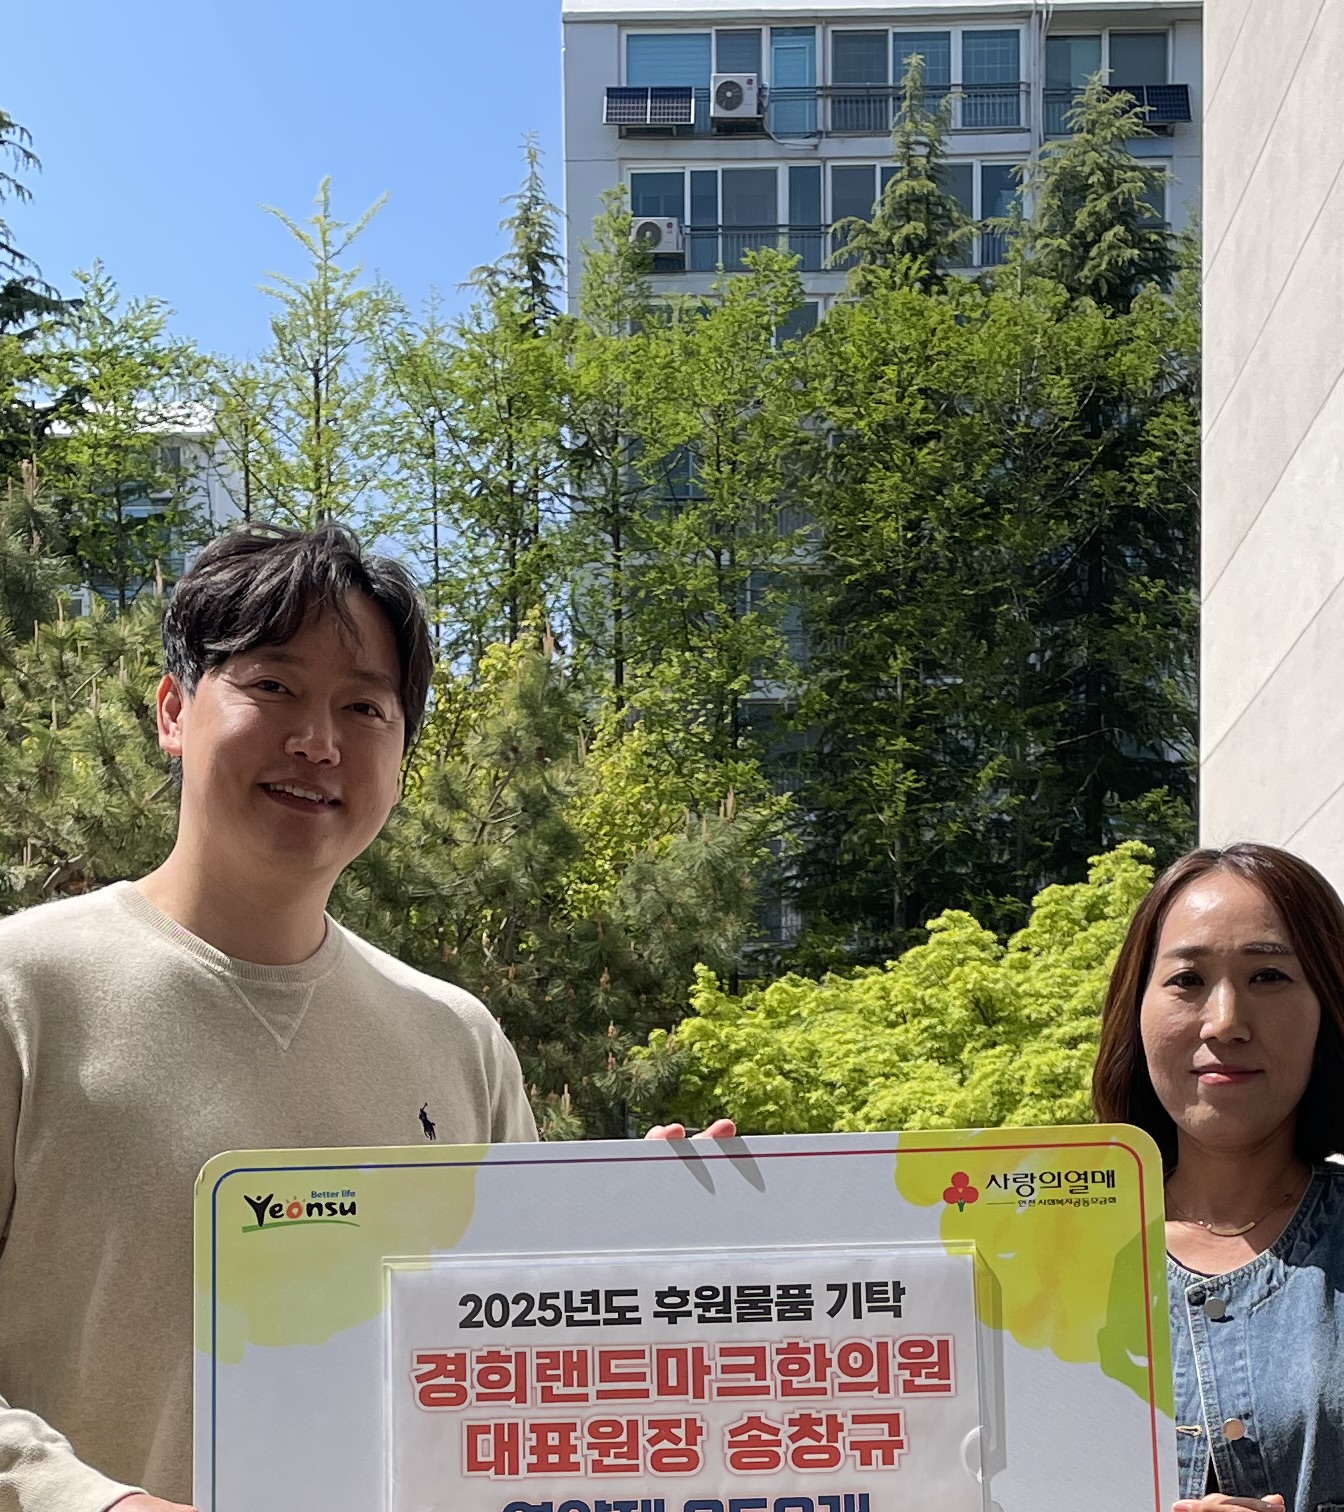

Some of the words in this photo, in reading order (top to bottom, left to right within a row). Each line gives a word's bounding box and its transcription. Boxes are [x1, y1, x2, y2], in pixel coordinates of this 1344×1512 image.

[311, 1190, 339, 1198] Better
[342, 1190, 356, 1198] life
[985, 1170, 1116, 1198] 사랑의열매
[244, 1194, 356, 1227] Yeonsu
[458, 1287, 641, 1331] 2025년도
[653, 1284, 812, 1325] 후원물품
[828, 1281, 905, 1321] 기탁
[412, 1339, 953, 1406] 경희랜드마크한의원
[466, 1415, 700, 1474] 대표원장
[726, 1411, 905, 1471] 송창규
